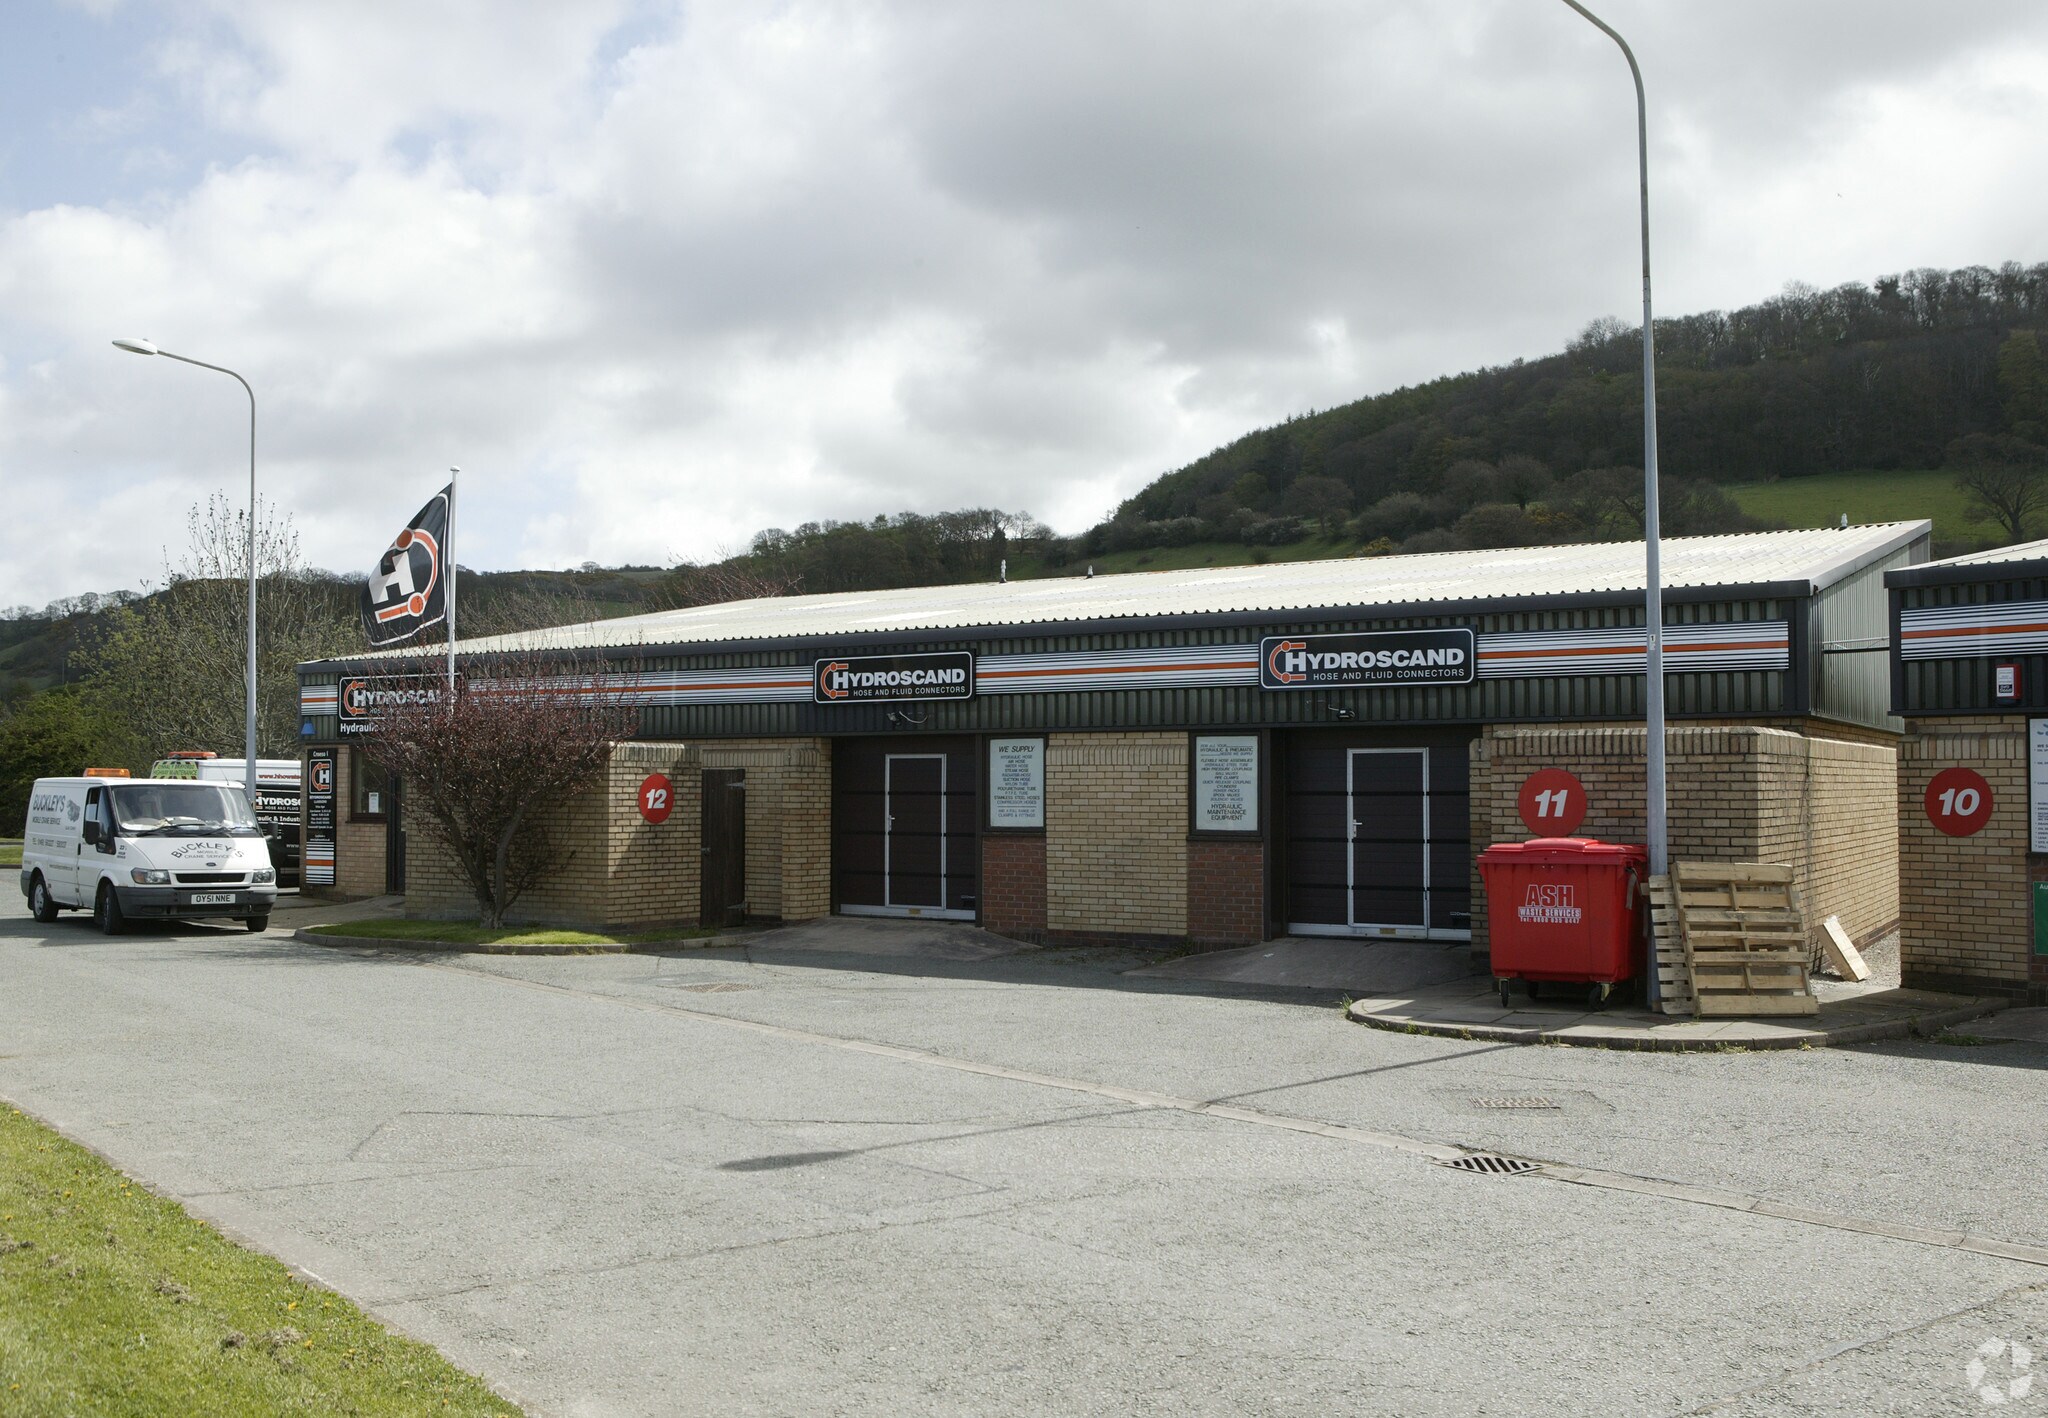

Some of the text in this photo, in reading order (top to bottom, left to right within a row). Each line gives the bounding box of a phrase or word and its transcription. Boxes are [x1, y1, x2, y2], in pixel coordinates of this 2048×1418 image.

[1285, 648, 1465, 672] HYDROSCAND
[832, 668, 966, 689] HYDROSCAND
[1313, 668, 1465, 681] HOSE AND FLUID CONNECTORS
[853, 685, 966, 697] HOSE AND FLUID CONNECTORS
[32, 794, 66, 812] BUCKLEY'S
[646, 788, 667, 808] 12
[1534, 789, 1568, 818] 11
[1938, 788, 1980, 816] 10
[171, 842, 245, 858] BUCKLEY'S
[196, 894, 230, 903] OY51 NNE
[1525, 884, 1574, 908] ASH
[1520, 908, 1580, 918] WASTE SERVICES
